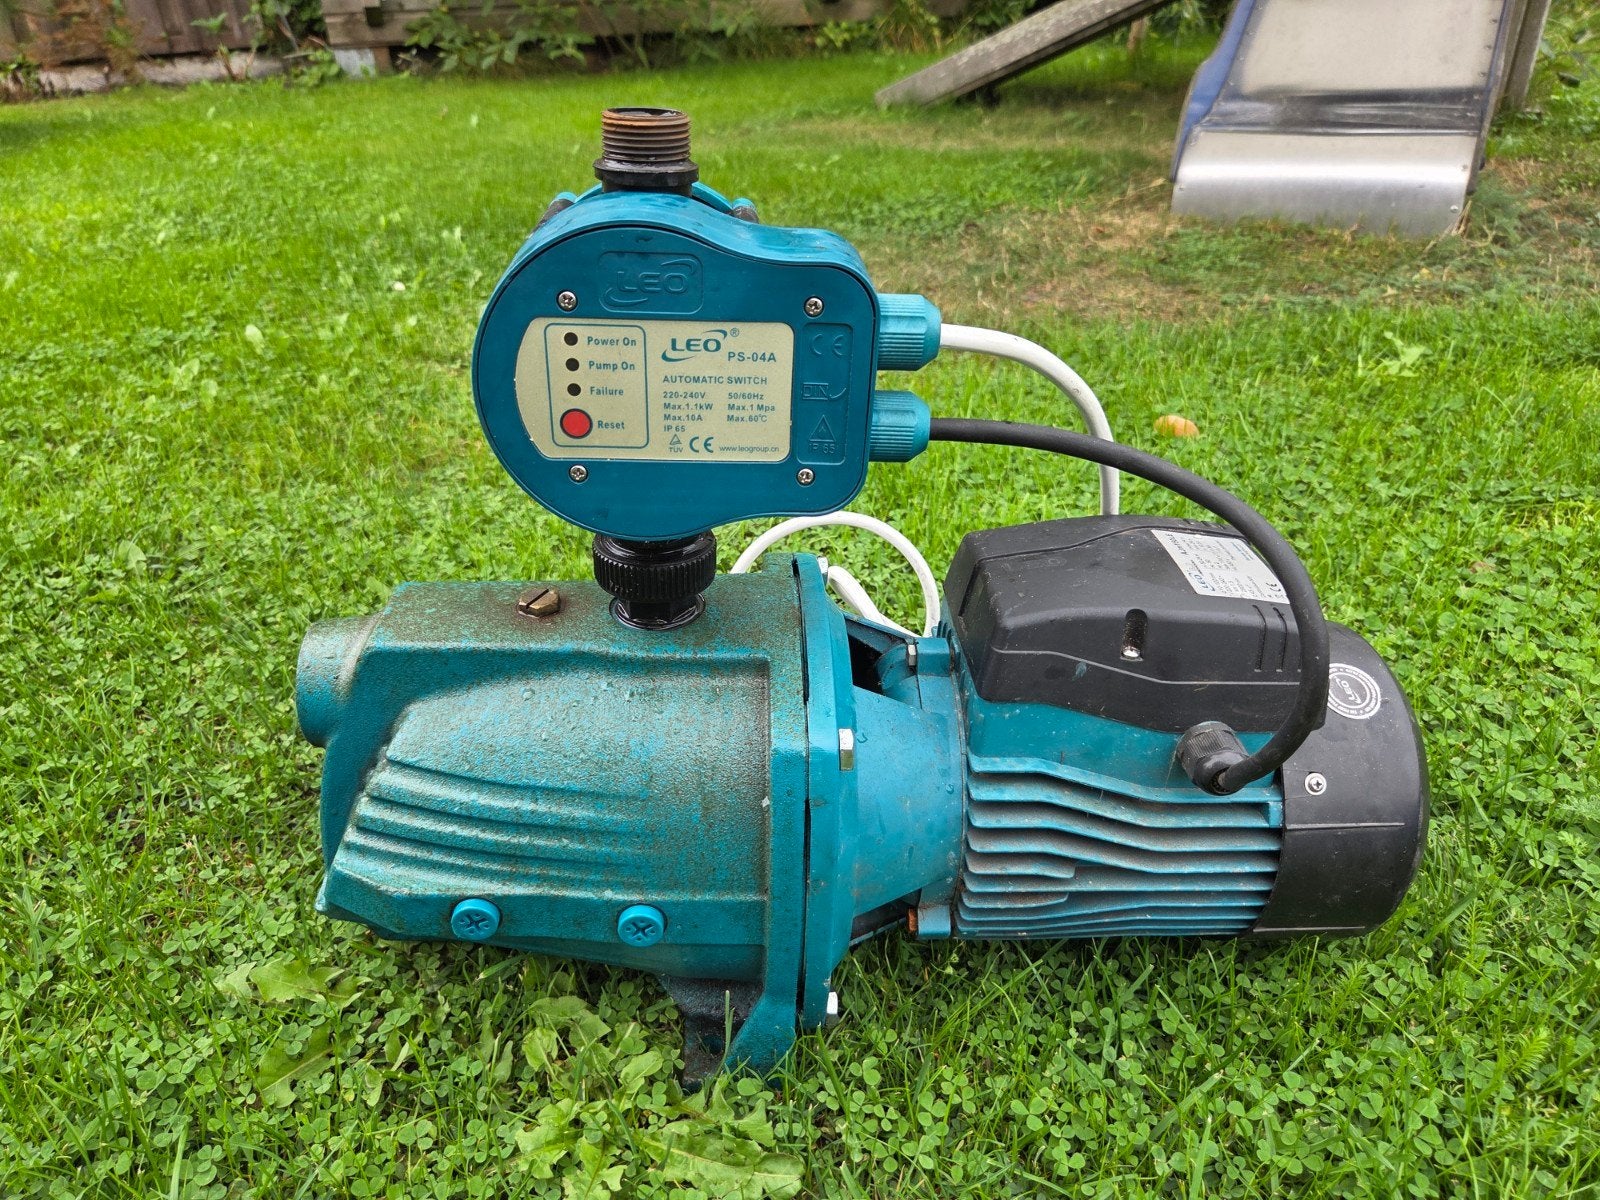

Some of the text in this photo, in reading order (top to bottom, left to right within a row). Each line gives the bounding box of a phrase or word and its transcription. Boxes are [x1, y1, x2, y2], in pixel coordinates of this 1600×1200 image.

[586, 336, 637, 346] Power On
[727, 351, 777, 363] PS-04A
[588, 360, 635, 372] Pump On
[662, 375, 768, 385] AUTOMATIC SWITCH
[589, 386, 624, 396] Failure
[662, 391, 706, 399] 220-240V
[728, 392, 764, 400] 50/60Hz
[663, 402, 714, 411] Max.1.1kW
[663, 413, 703, 421] Max.10A
[597, 420, 625, 429] Reset
[719, 445, 780, 454] www.leogroup.cn
